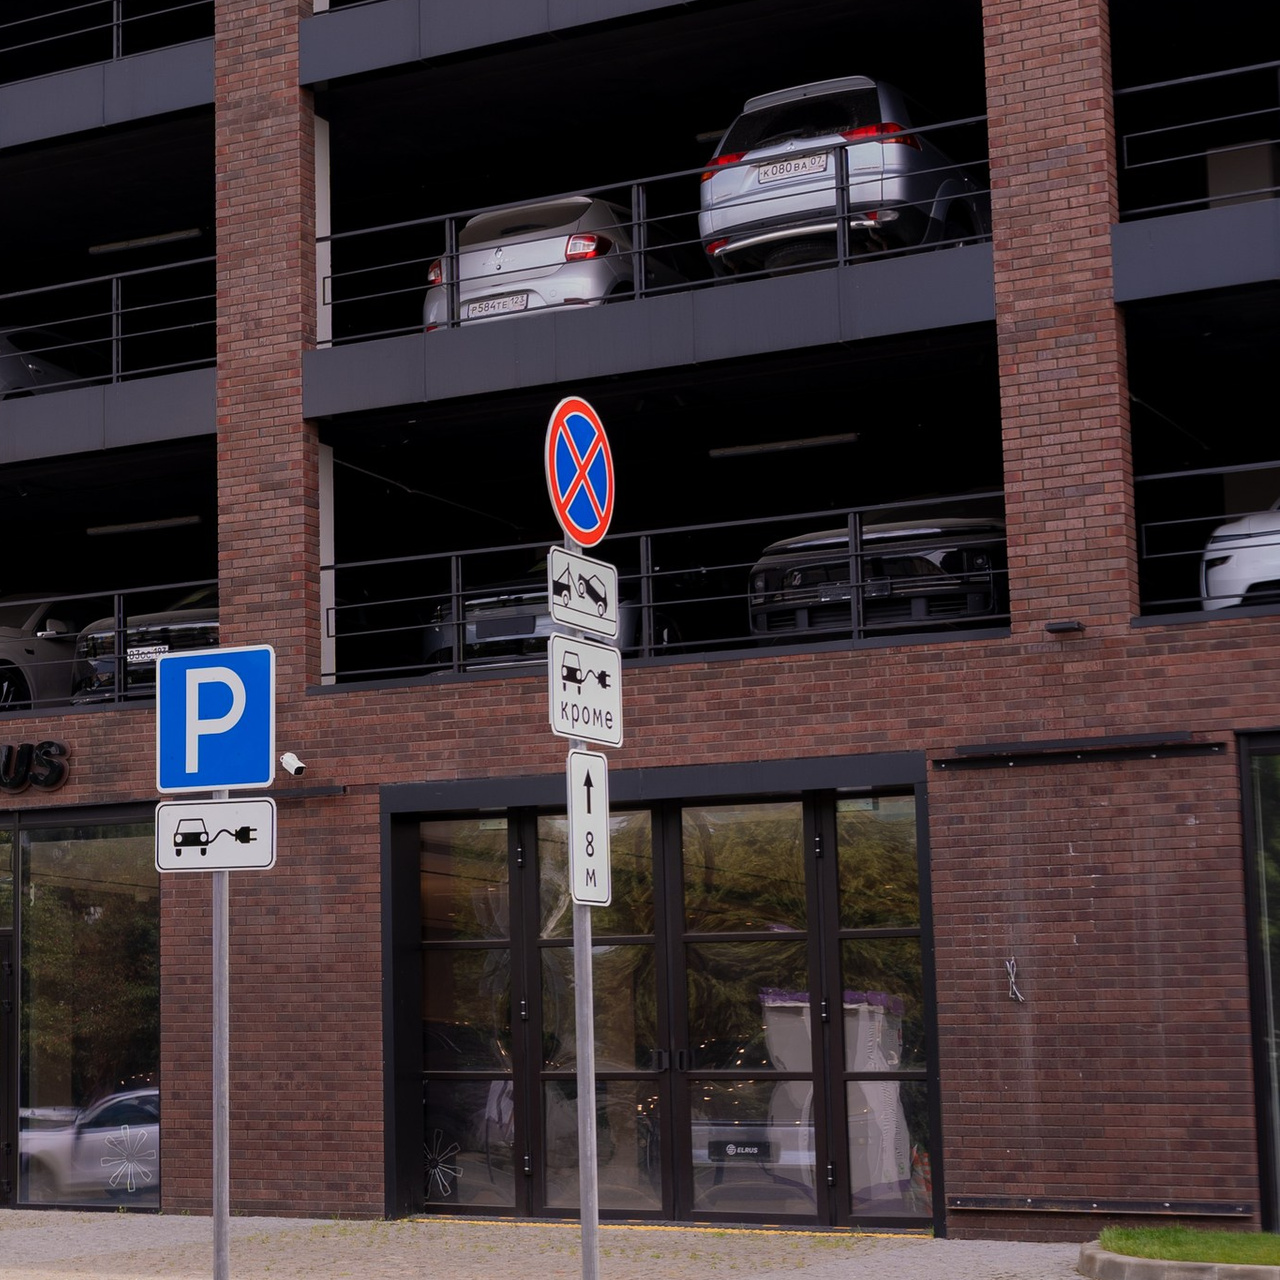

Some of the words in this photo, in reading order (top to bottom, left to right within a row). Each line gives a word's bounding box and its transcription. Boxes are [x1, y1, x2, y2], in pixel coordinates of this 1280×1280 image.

[185, 666, 247, 774] P
[560, 700, 613, 730] кроме
[585, 830, 595, 858] 8
